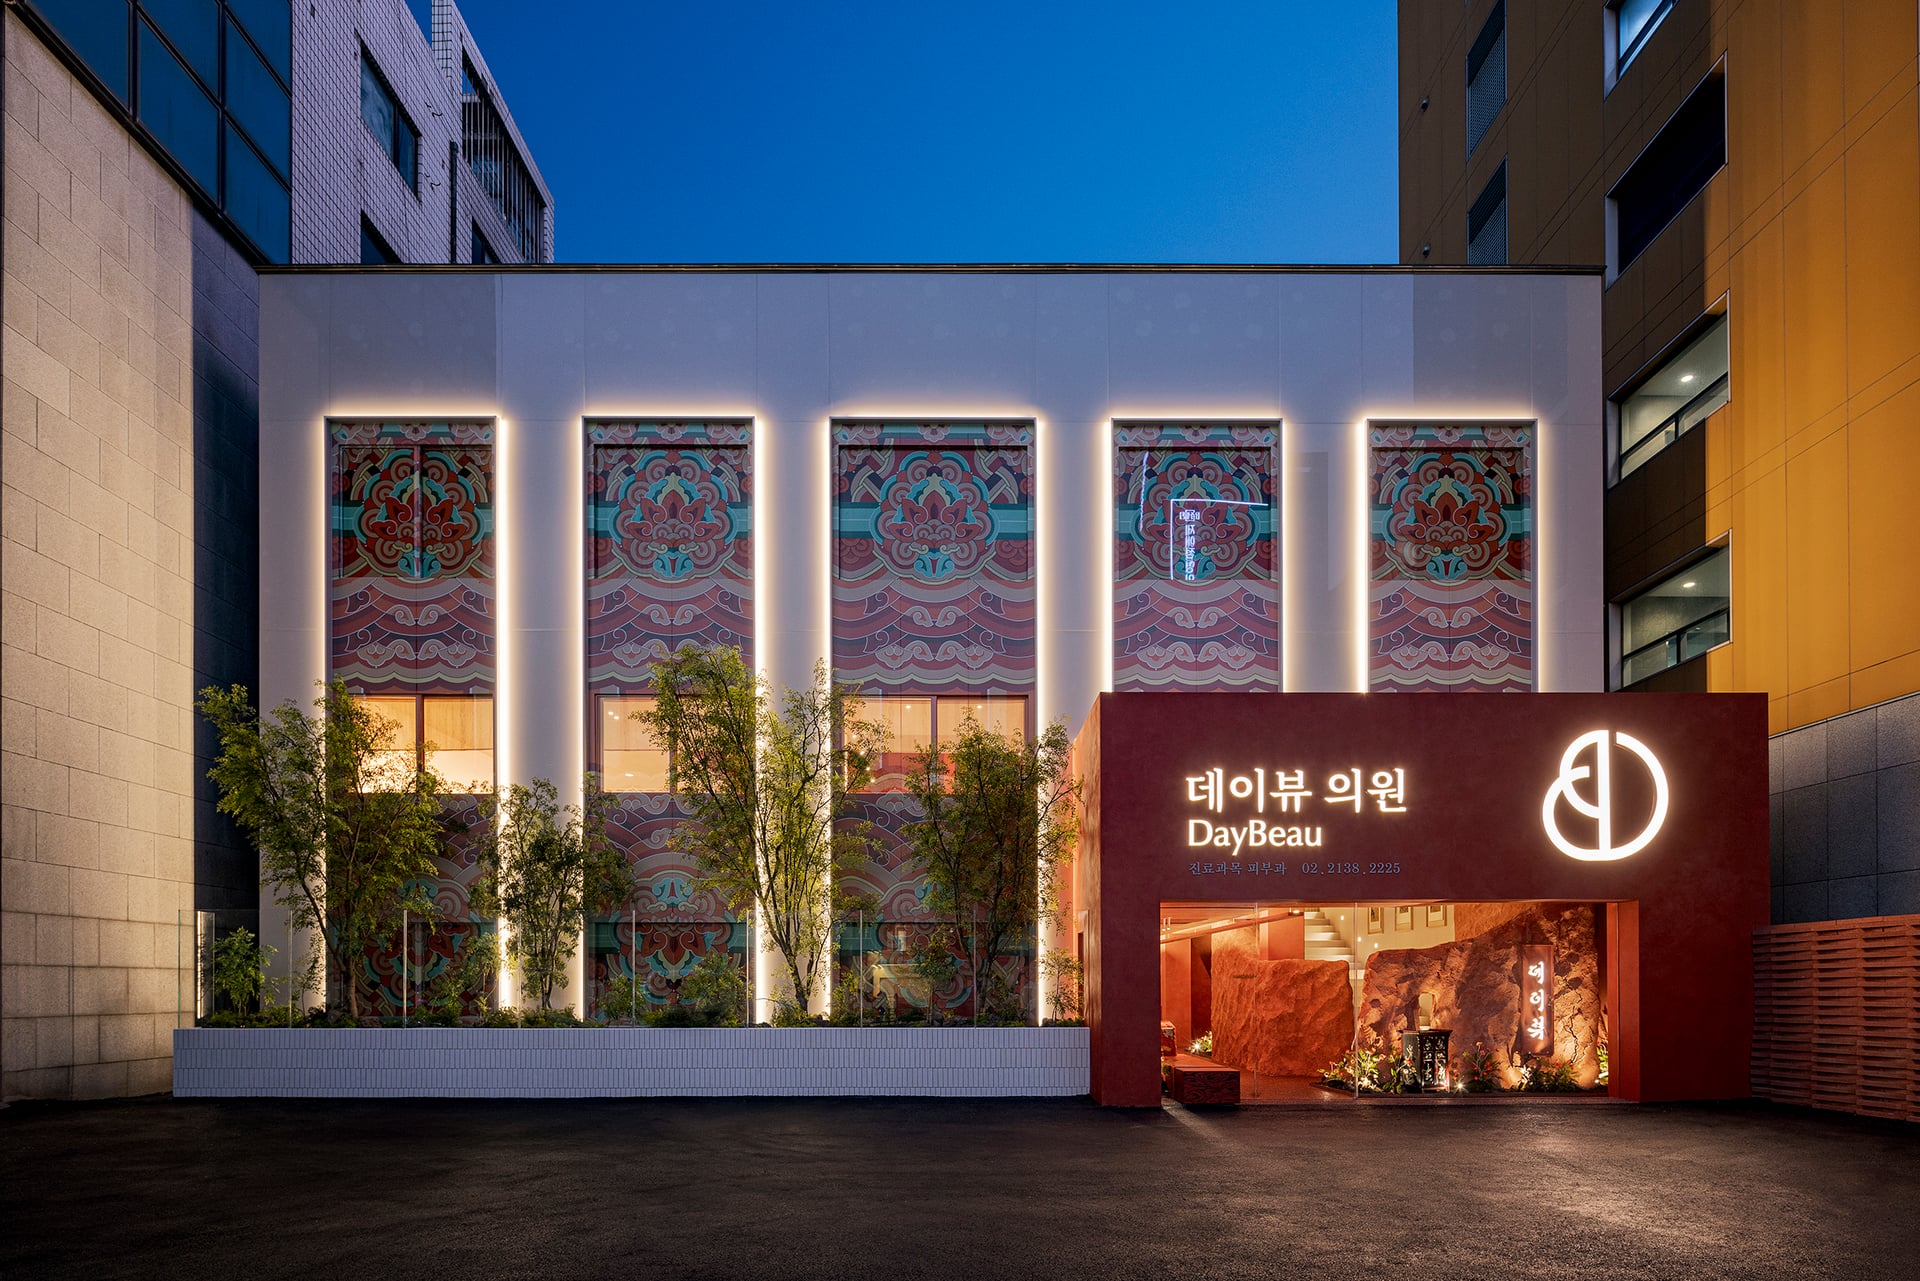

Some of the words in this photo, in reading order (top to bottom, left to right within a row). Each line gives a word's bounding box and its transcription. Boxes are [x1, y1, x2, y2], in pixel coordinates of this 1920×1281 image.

[1186, 767, 1313, 813] 데이뷰
[1324, 767, 1407, 813] 의원
[1188, 819, 1322, 856] DayBeau
[1189, 861, 1242, 876] 진료과목
[1248, 861, 1287, 876] 피부과
